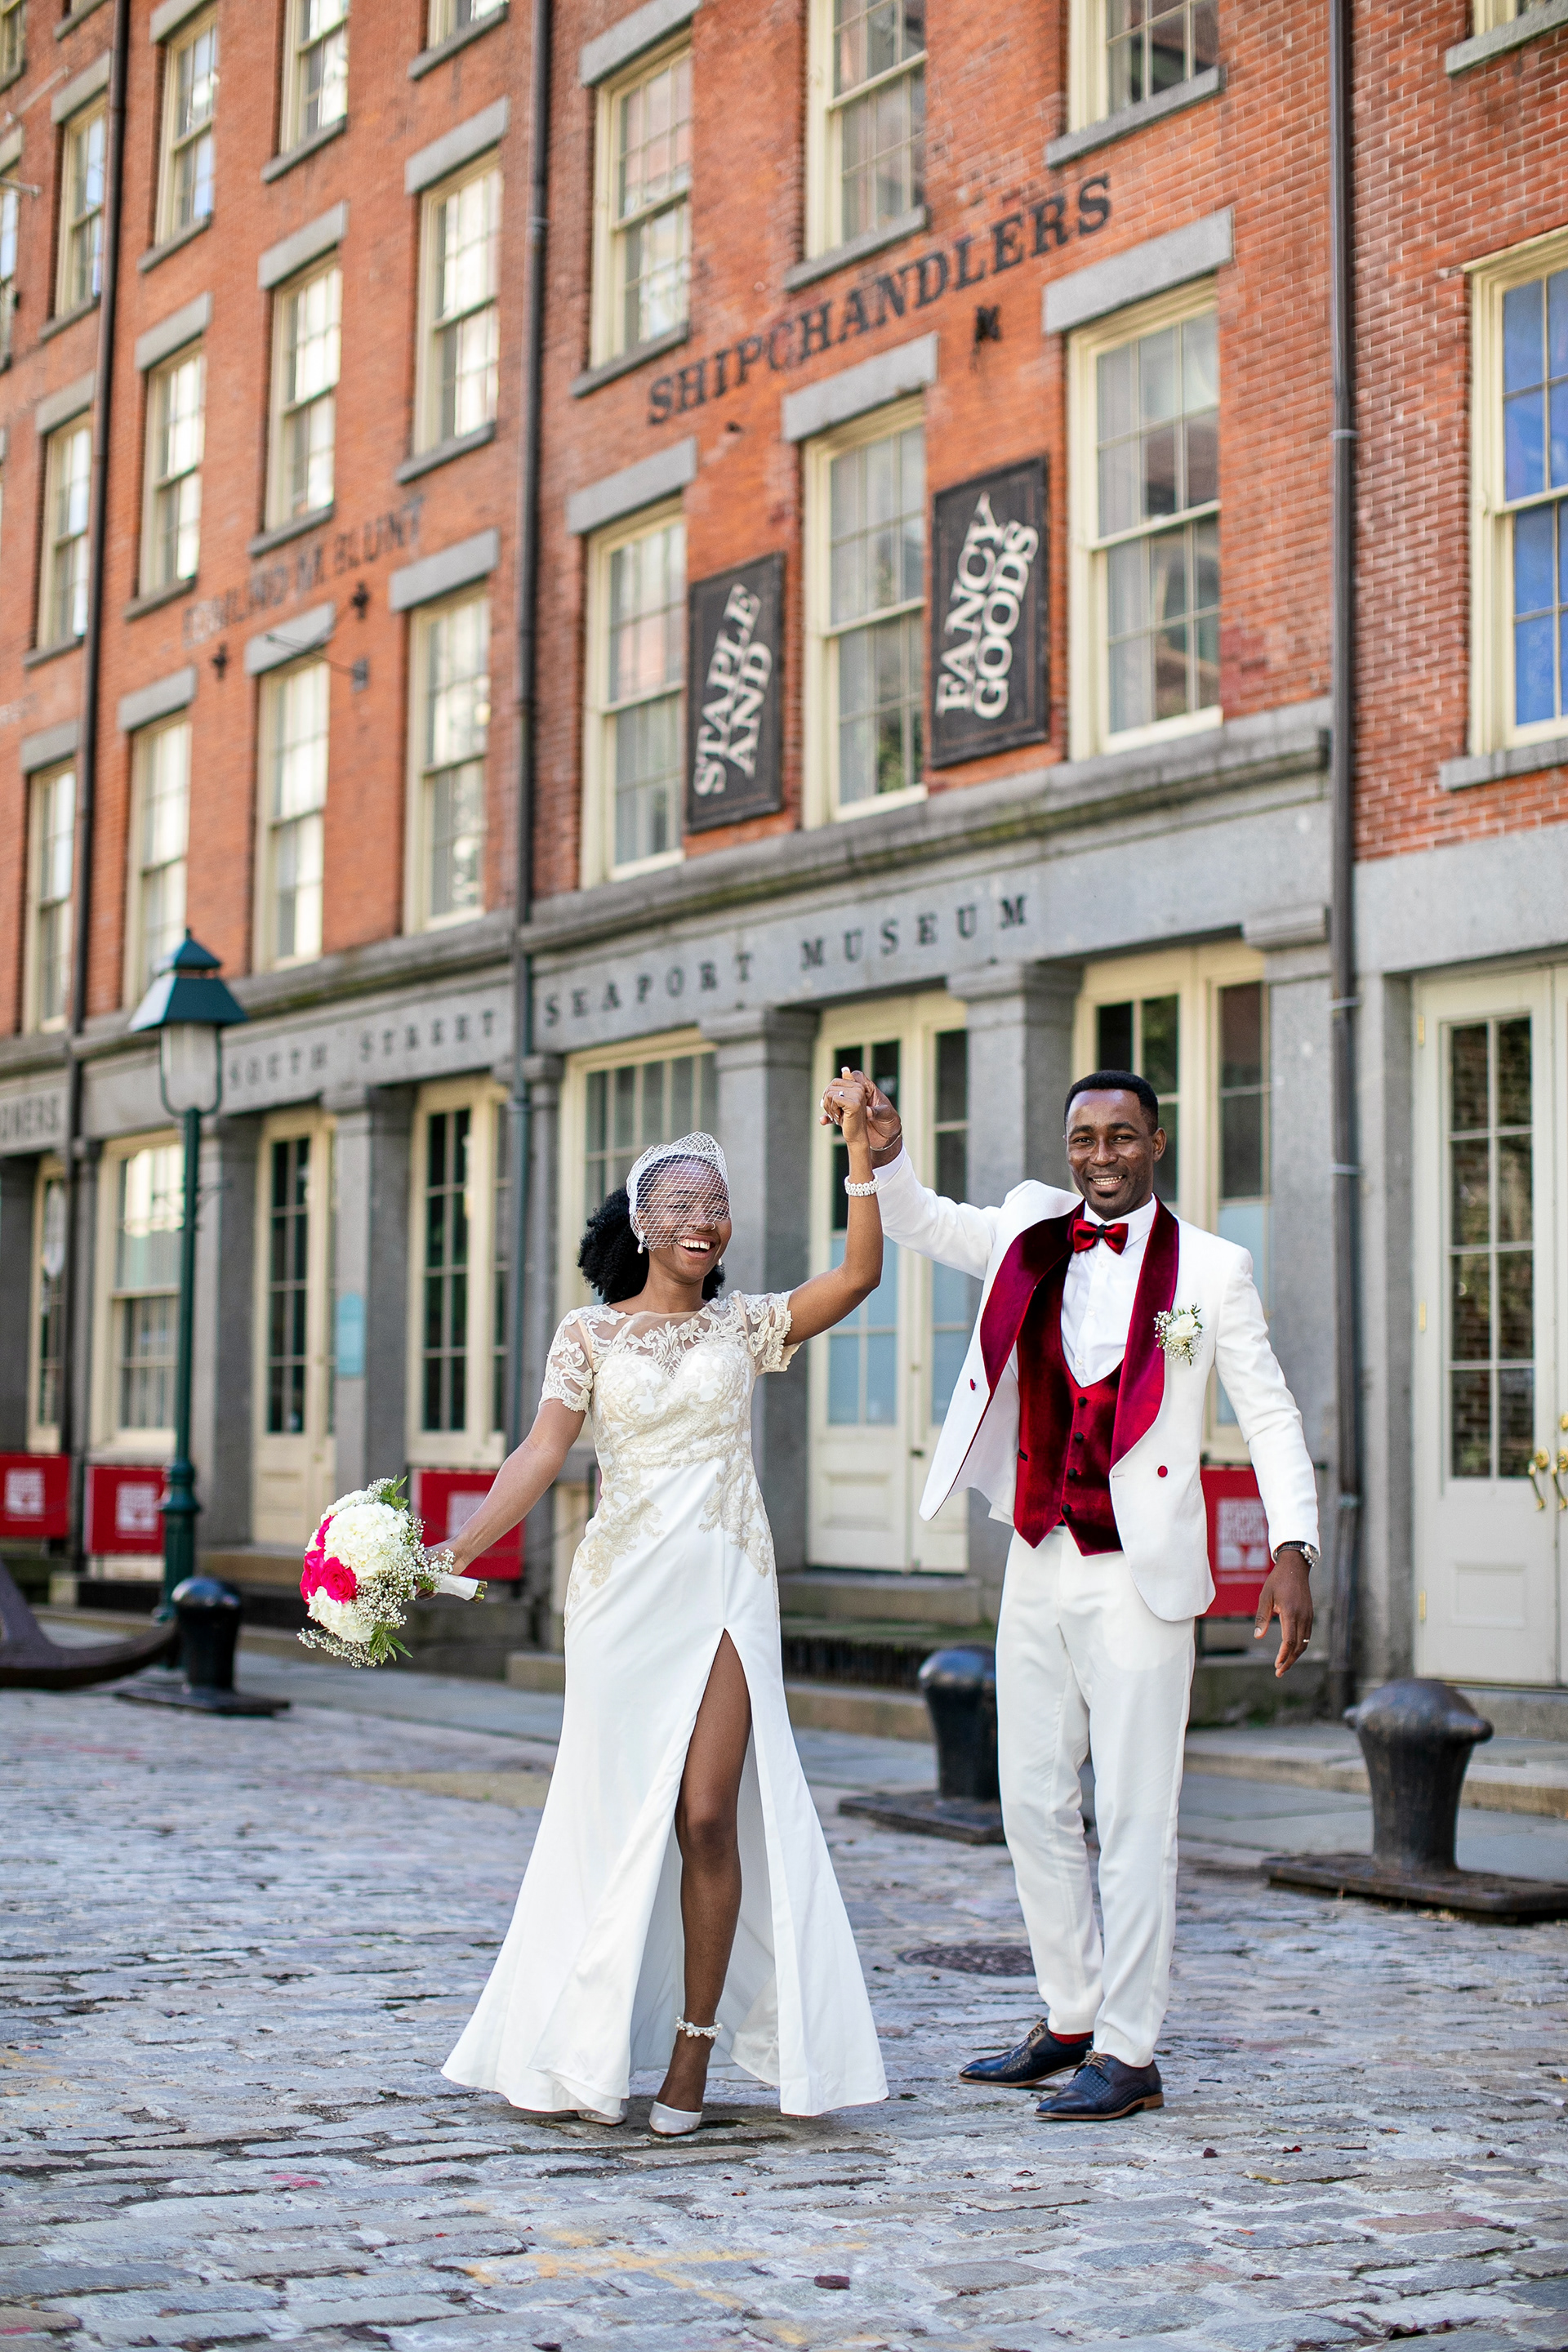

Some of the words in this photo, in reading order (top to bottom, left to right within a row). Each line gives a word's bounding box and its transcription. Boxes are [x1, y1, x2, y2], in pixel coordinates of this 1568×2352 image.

[693, 583, 762, 796] STAPLE
[934, 492, 1005, 718] FANCY
[972, 519, 1040, 720] GOODS
[724, 641, 773, 777] AND
[359, 1008, 497, 1064] STREET
[544, 951, 755, 1026] SEAPORT
[801, 893, 1028, 971] MUSEUM
